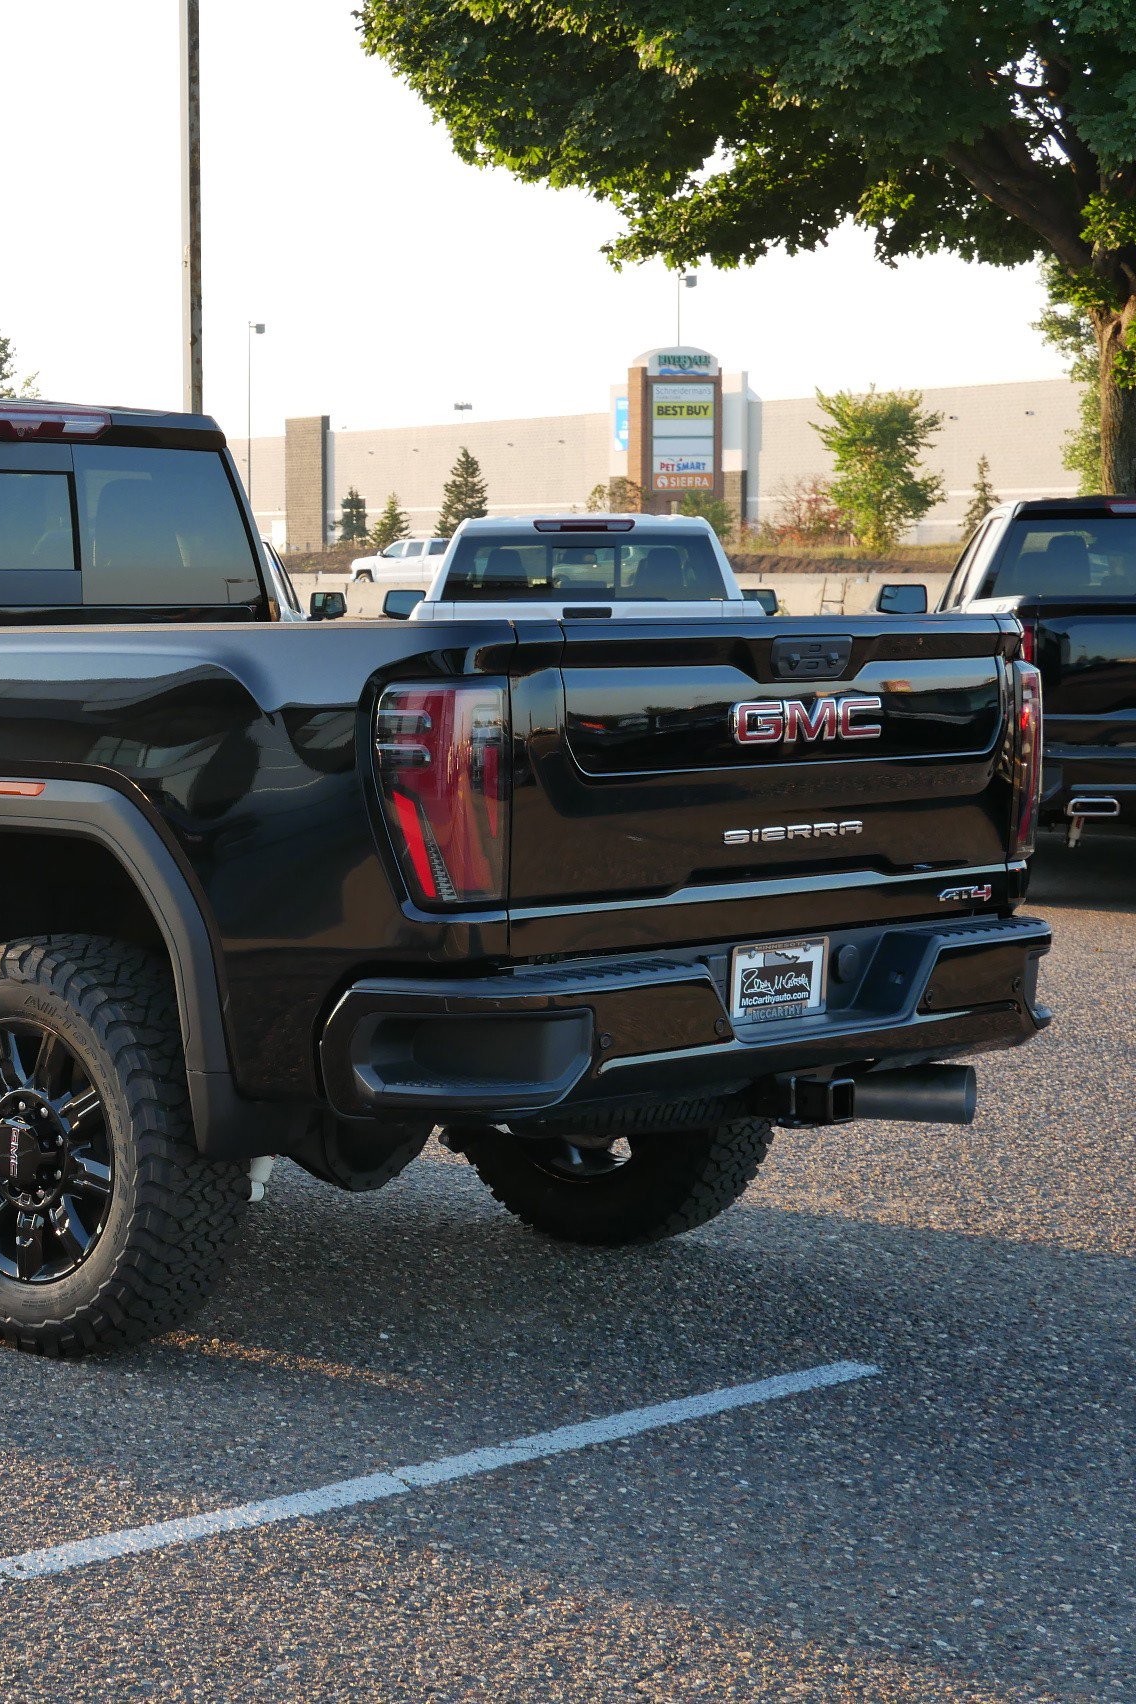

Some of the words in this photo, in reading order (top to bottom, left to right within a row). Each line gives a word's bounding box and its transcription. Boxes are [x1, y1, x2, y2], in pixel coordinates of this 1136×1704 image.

[657, 405, 685, 416] BEST
[686, 405, 710, 416] BUY
[670, 476, 709, 487] SIERRA
[730, 695, 882, 745] GMC
[723, 820, 863, 845] SIERRA
[938, 884, 992, 902] AT4
[754, 941, 807, 951] MINNESOTA
[741, 991, 809, 1006] McCarthyauto.com
[752, 1004, 801, 1020] MCCARTHY
[10, 1126, 20, 1178] GMC
